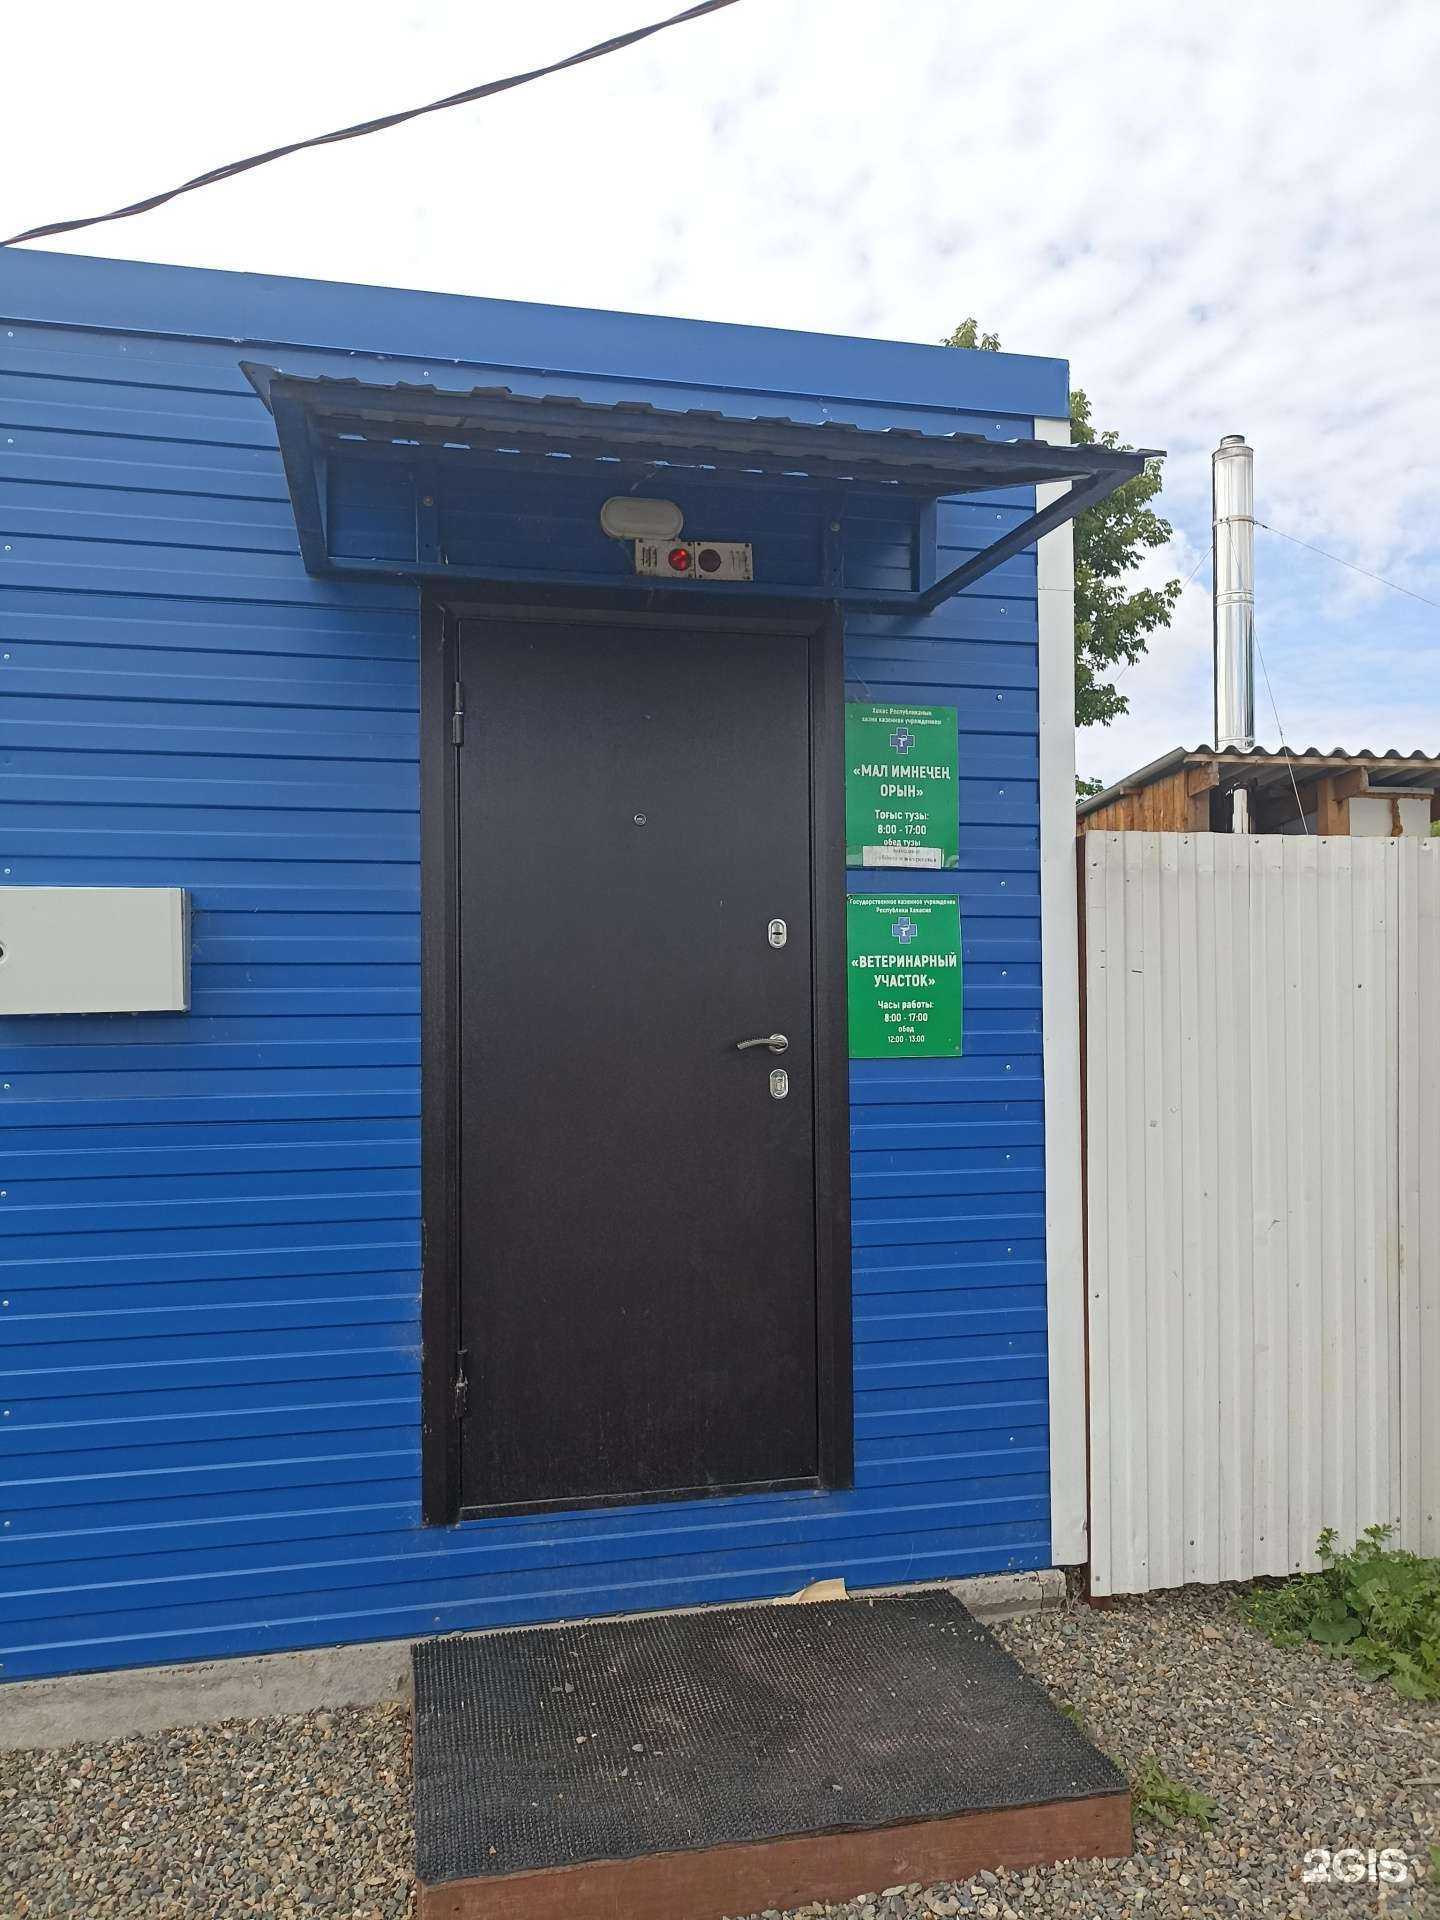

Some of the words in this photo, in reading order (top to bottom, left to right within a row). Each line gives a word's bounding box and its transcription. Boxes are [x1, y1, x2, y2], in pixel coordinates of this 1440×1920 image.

[853, 764, 888, 777] «МАЛ
[880, 784, 924, 797] ОРЫН»
[877, 824, 897, 834] 8:00
[905, 825, 927, 835] 17:00
[883, 838, 901, 846] обед
[851, 952, 957, 968] «ВЕТЕРИНАРНЫЙ
[874, 974, 936, 987] УЧАСТОК»
[877, 1000, 900, 1009] Часы
[902, 1000, 935, 1010] работы:
[884, 1013, 901, 1022] 8:00
[908, 1013, 928, 1022] 17:00
[898, 1025, 915, 1033] обед
[887, 1035, 904, 1043] 12:00
[909, 1035, 925, 1043] 13:00
